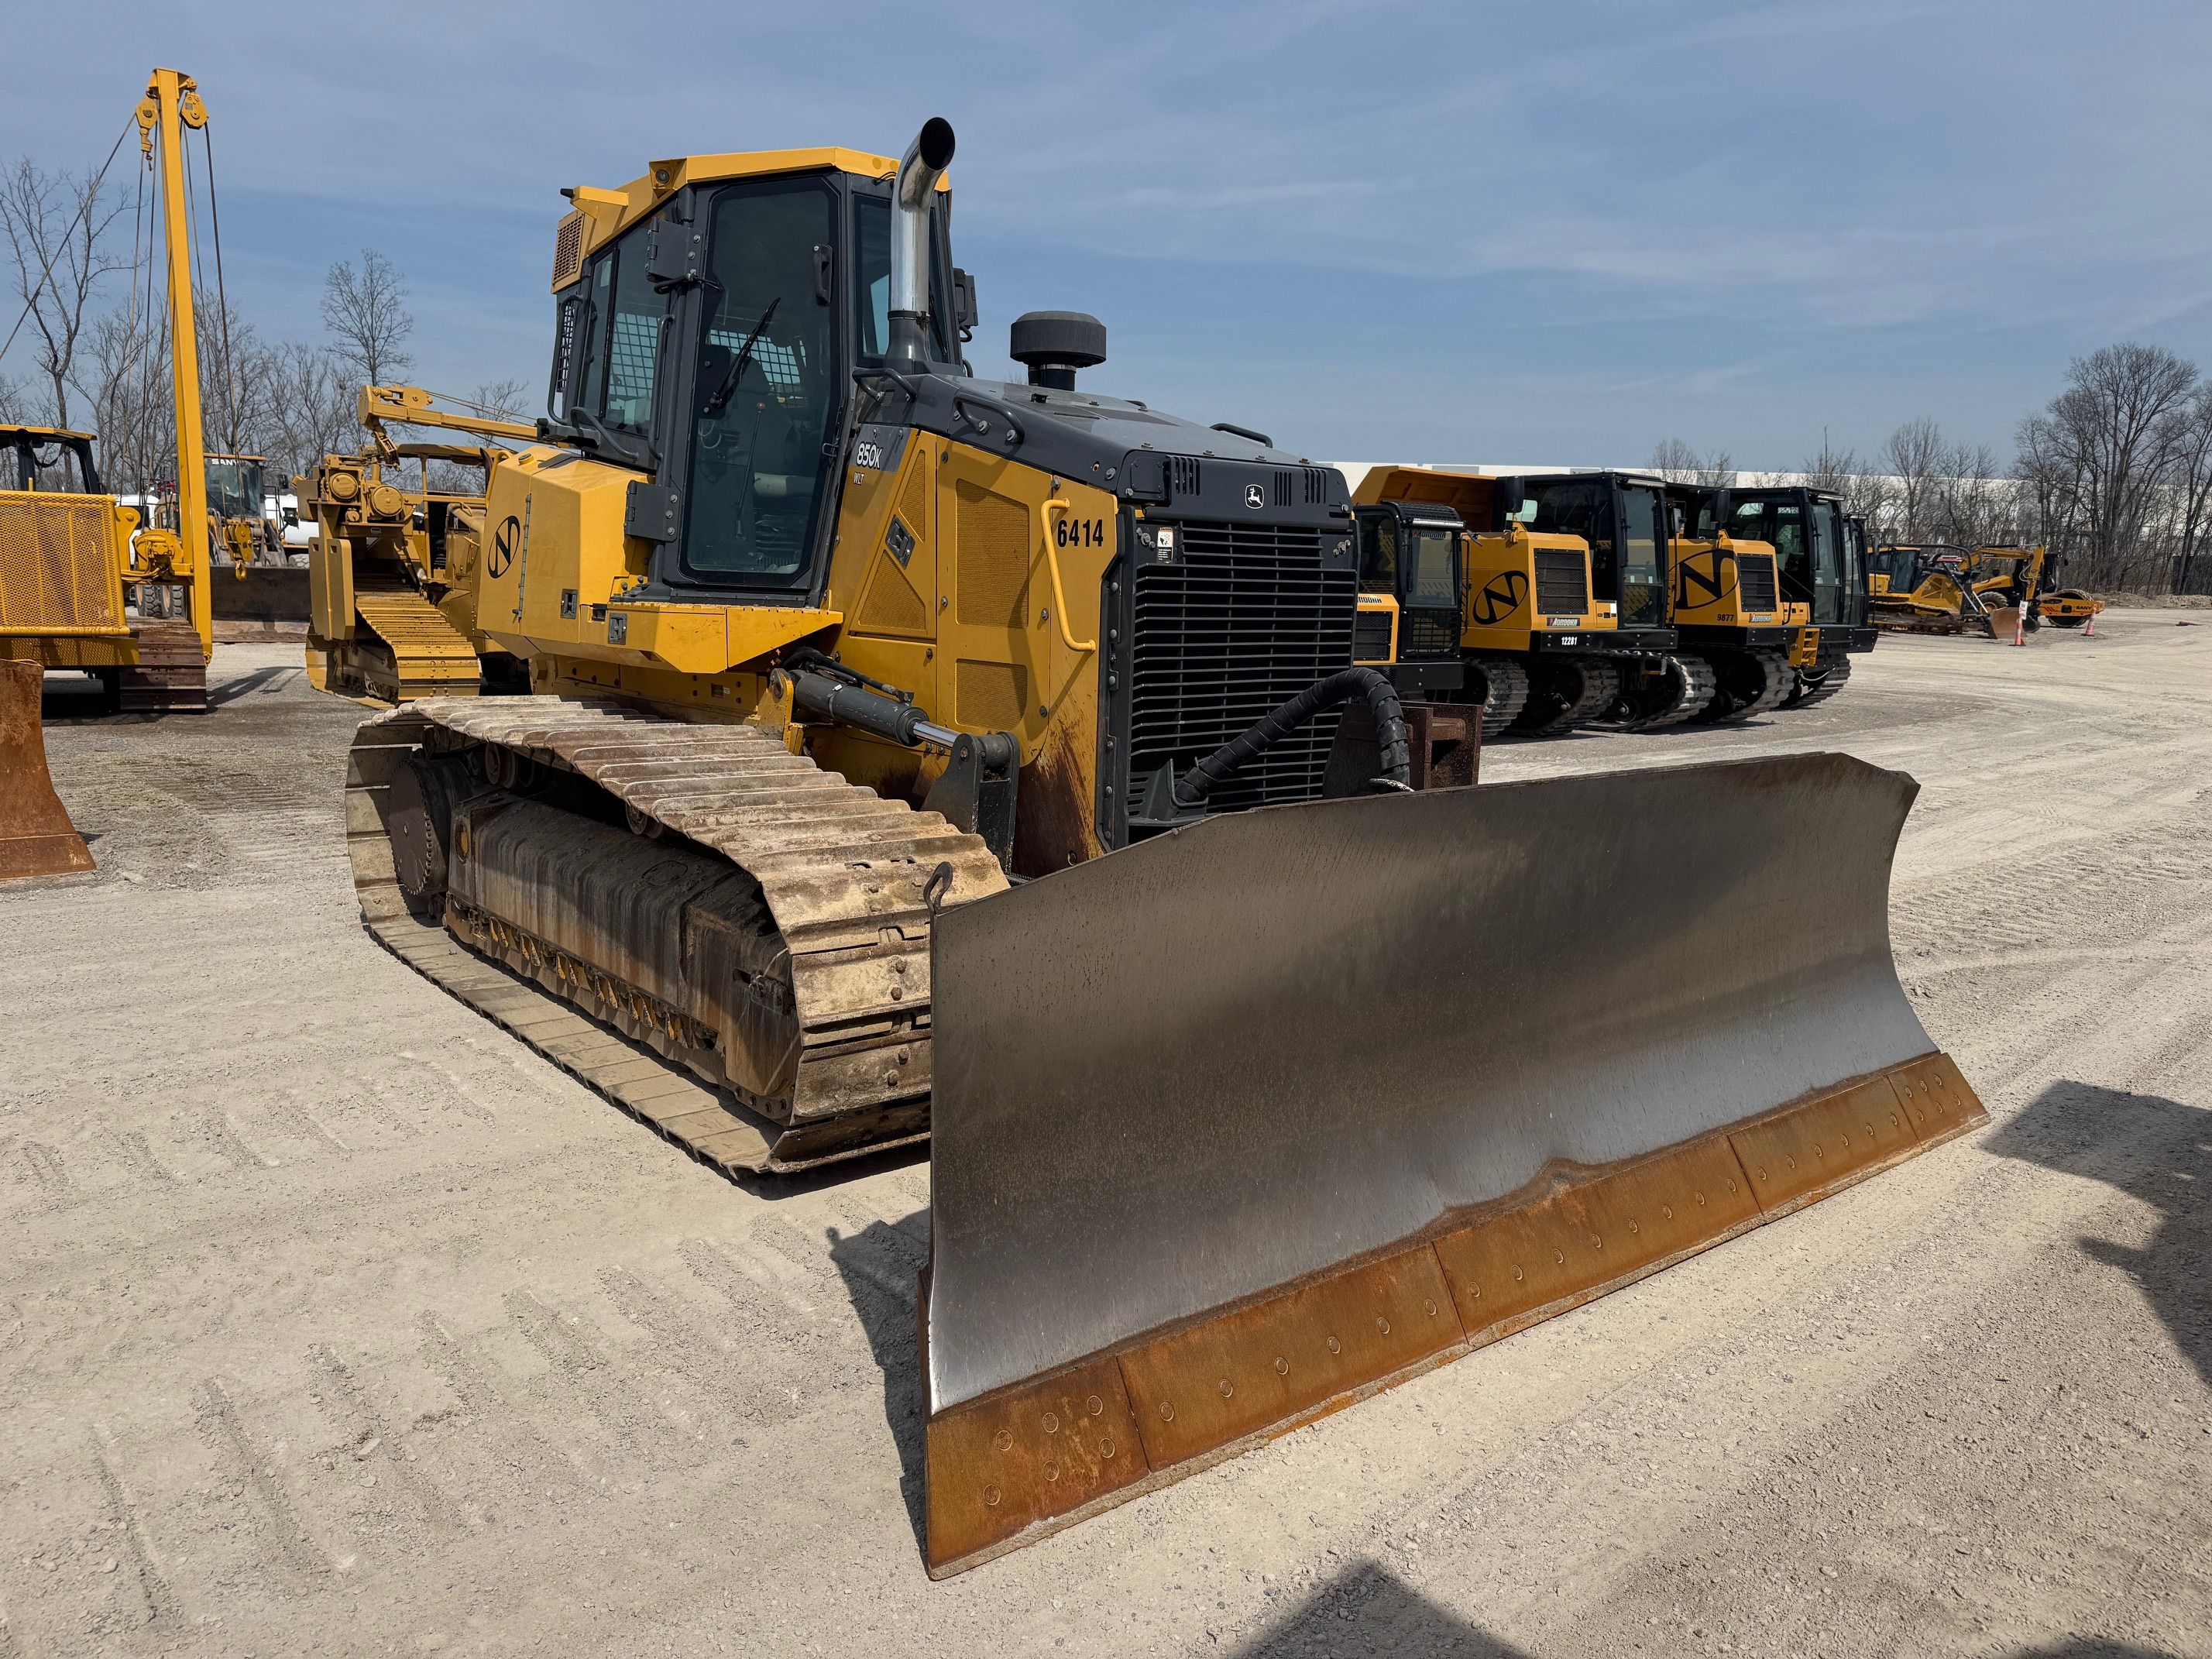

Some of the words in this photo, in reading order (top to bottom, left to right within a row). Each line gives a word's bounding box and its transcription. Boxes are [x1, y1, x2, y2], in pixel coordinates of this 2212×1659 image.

[856, 441, 883, 469] 850K
[854, 472, 865, 486] WLT
[1057, 519, 1104, 548] 6414
[1716, 613, 1735, 622] 9877
[1561, 636, 1578, 646] 12281
